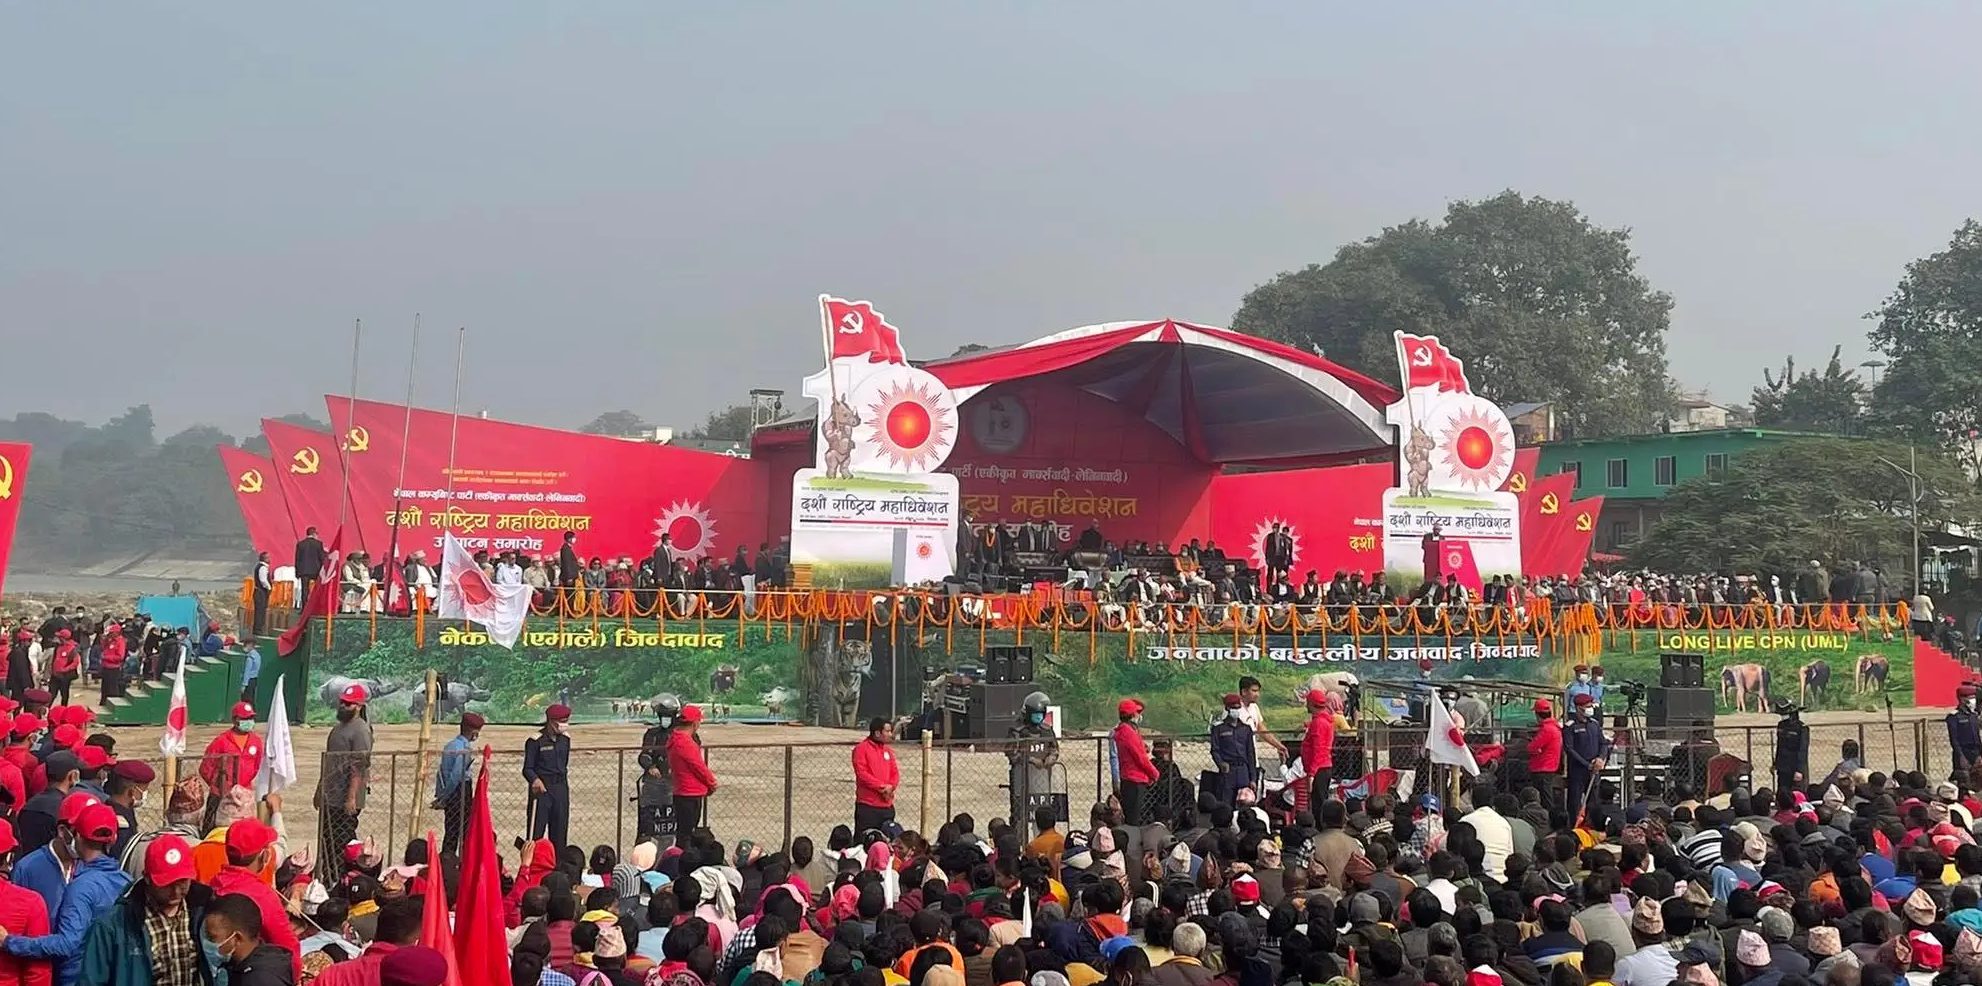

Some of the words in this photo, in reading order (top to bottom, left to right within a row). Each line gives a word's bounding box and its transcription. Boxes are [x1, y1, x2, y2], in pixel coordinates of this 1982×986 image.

[832, 494, 876, 515] राष्ट्रिय
[880, 496, 949, 515] महाधिवेशन
[1011, 488, 1137, 518] महाधिवेशन
[429, 506, 491, 534] राष्ट्रिय
[495, 508, 592, 532] महाधिवेशन
[1455, 512, 1512, 530] महाधिवेशन
[492, 536, 544, 551] समारोह
[1660, 635, 1709, 649] LONG
[1716, 635, 1755, 649] LIVE
[1760, 635, 1796, 650] CPN
[1801, 635, 1848, 651] (UML)
[1147, 644, 1262, 661] जनताको
[1030, 744, 1045, 752] APF
